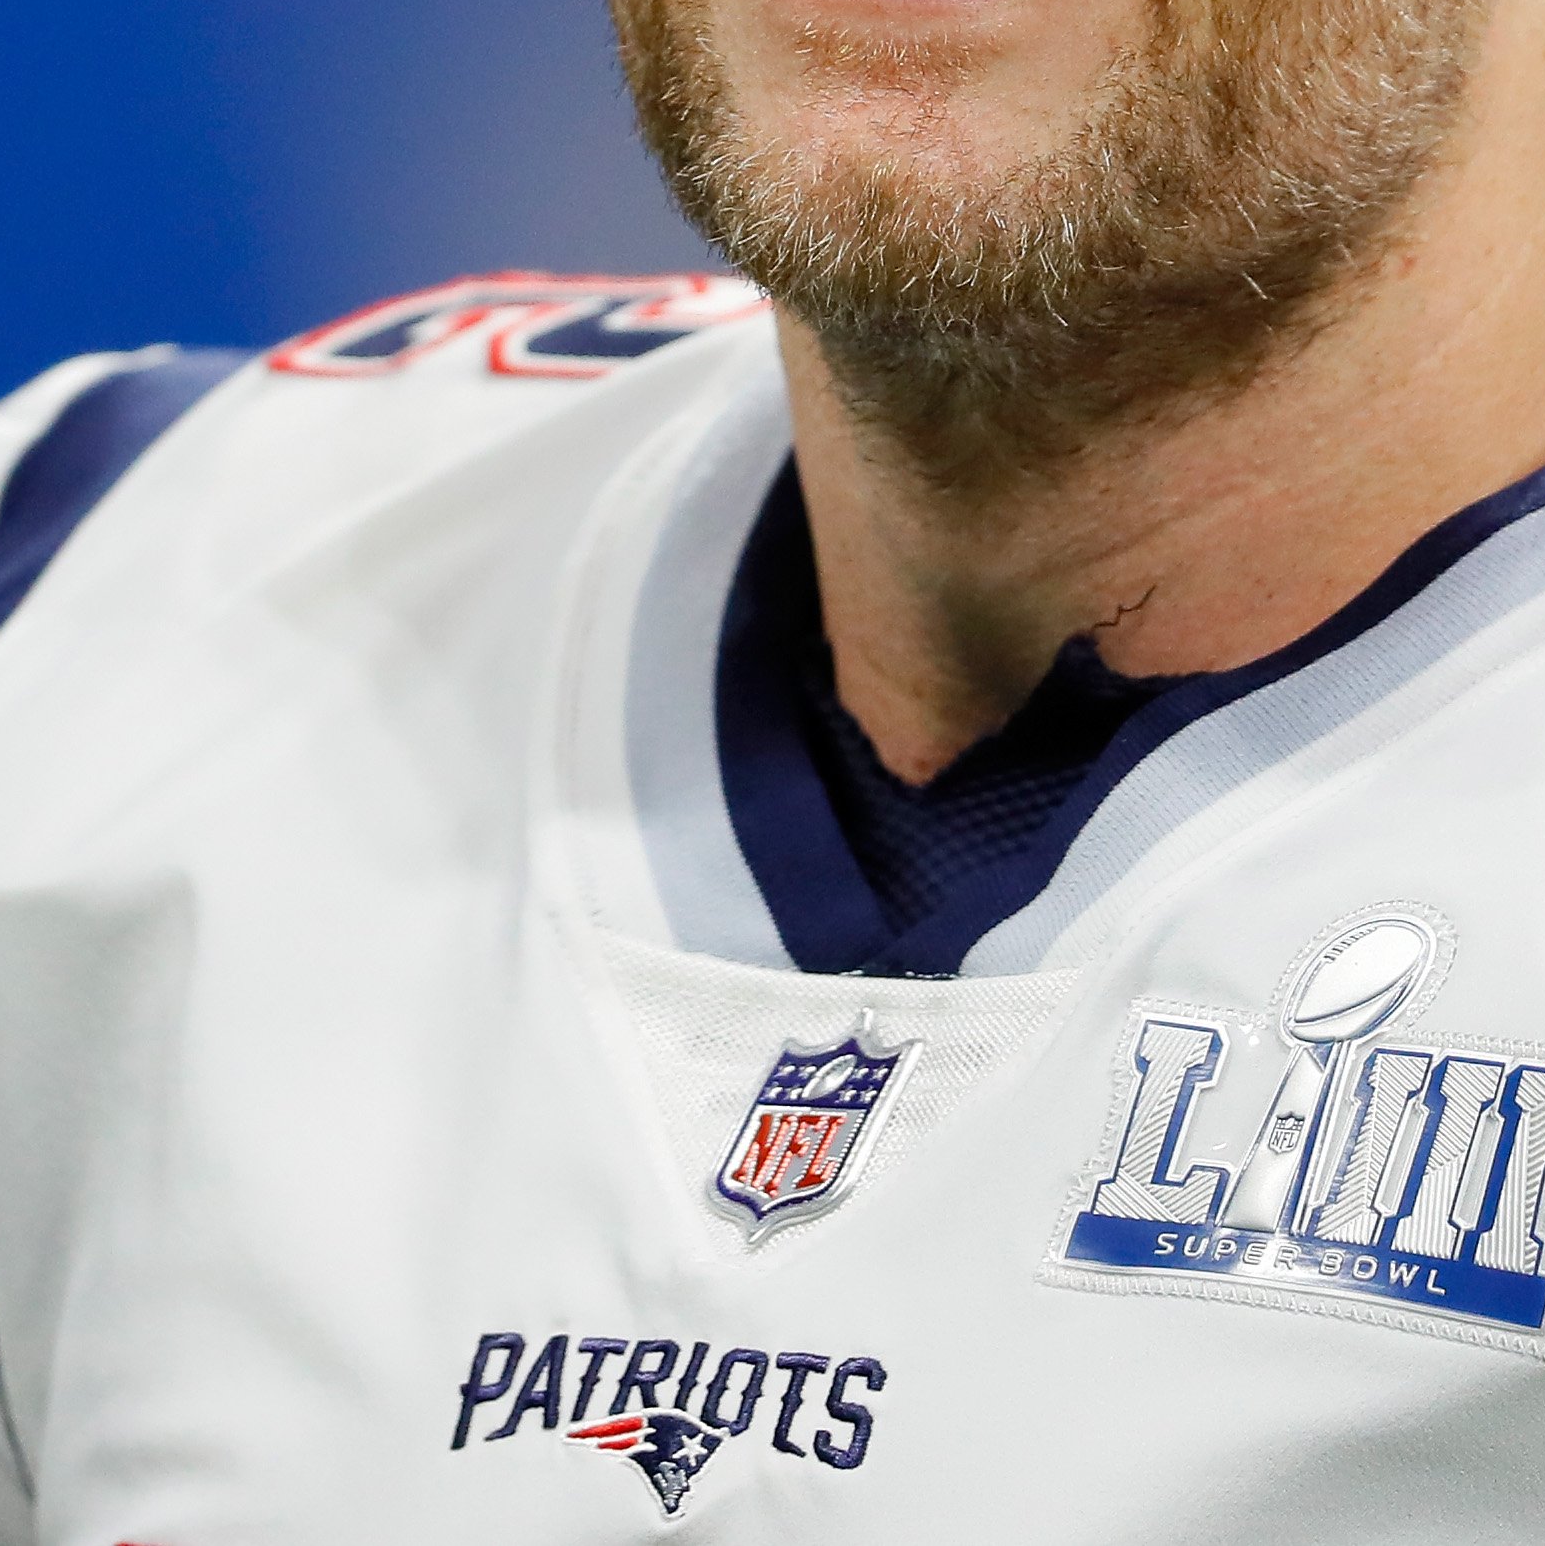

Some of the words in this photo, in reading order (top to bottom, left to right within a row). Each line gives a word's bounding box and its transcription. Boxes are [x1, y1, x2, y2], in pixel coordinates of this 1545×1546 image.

[731, 1113, 848, 1197] NFL
[1271, 1130, 1295, 1150] NFL
[1153, 1231, 1303, 1271] SUPER
[1319, 1248, 1447, 1297] BOWL
[450, 1331, 888, 1470] PATRIOTS
